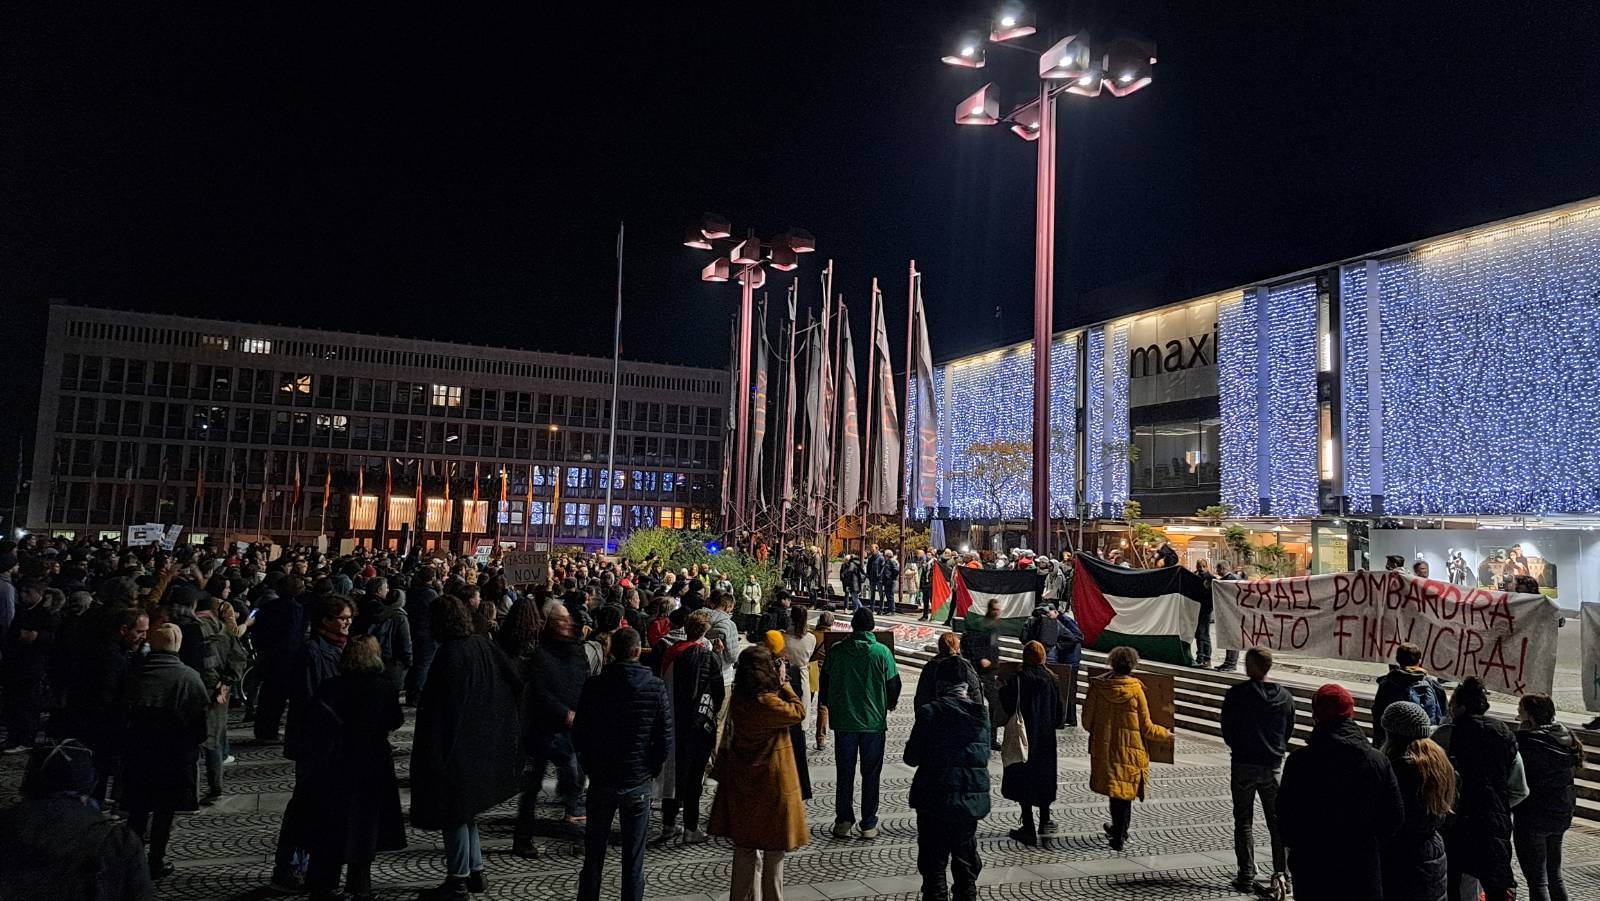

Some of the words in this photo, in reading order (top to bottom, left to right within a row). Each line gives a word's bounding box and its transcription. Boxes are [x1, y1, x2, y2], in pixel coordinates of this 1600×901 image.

[1131, 323, 1218, 378] maxi
[514, 568, 541, 581] NOW
[1235, 577, 1320, 611] IZRAEL
[1333, 573, 1514, 633] BOMBARDIRA
[1240, 614, 1310, 650] NATO
